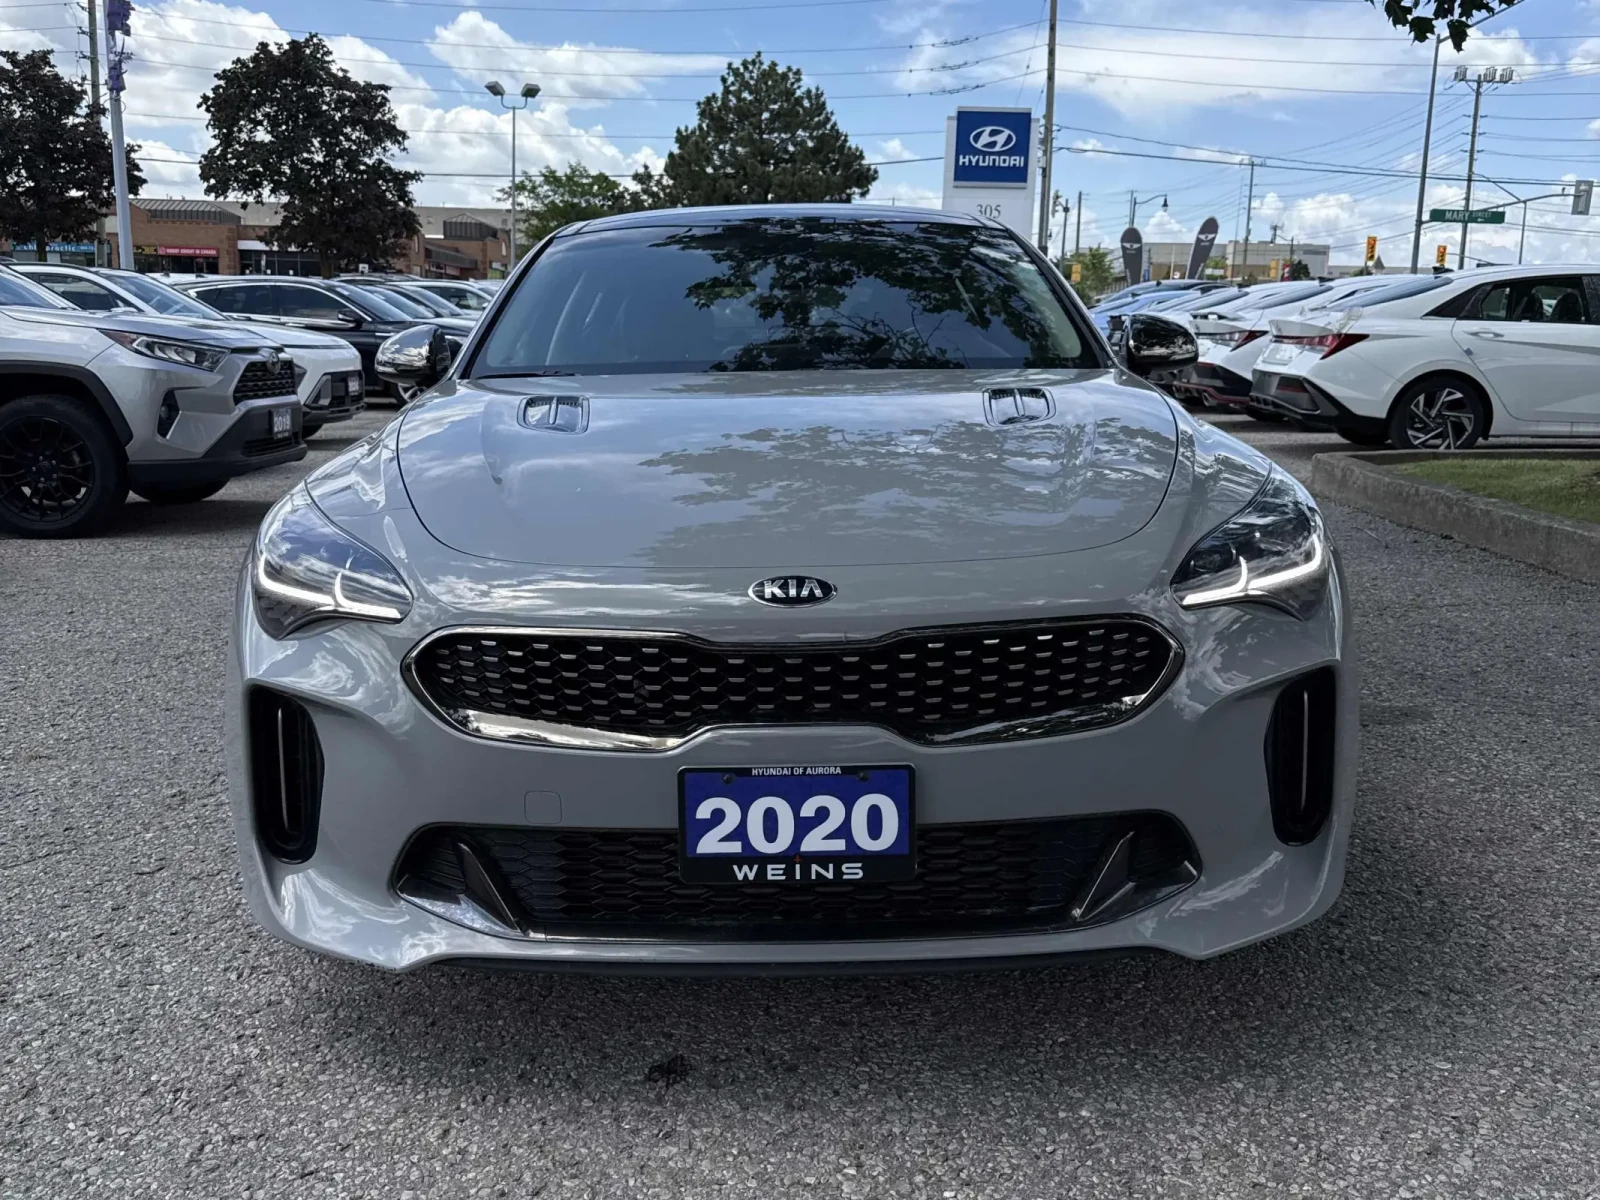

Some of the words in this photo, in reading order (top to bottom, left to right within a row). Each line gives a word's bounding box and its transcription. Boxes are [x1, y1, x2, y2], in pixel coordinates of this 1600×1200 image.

[959, 154, 1025, 167] HYUNDAI
[976, 203, 1001, 218] 305
[1445, 210, 1470, 220] MARY
[763, 579, 824, 599] KIA
[751, 767, 792, 776] HYUNDAI
[793, 767, 805, 775] OF
[805, 766, 842, 775] AURORA
[695, 793, 899, 854] 2020
[732, 862, 864, 881] WEINS
